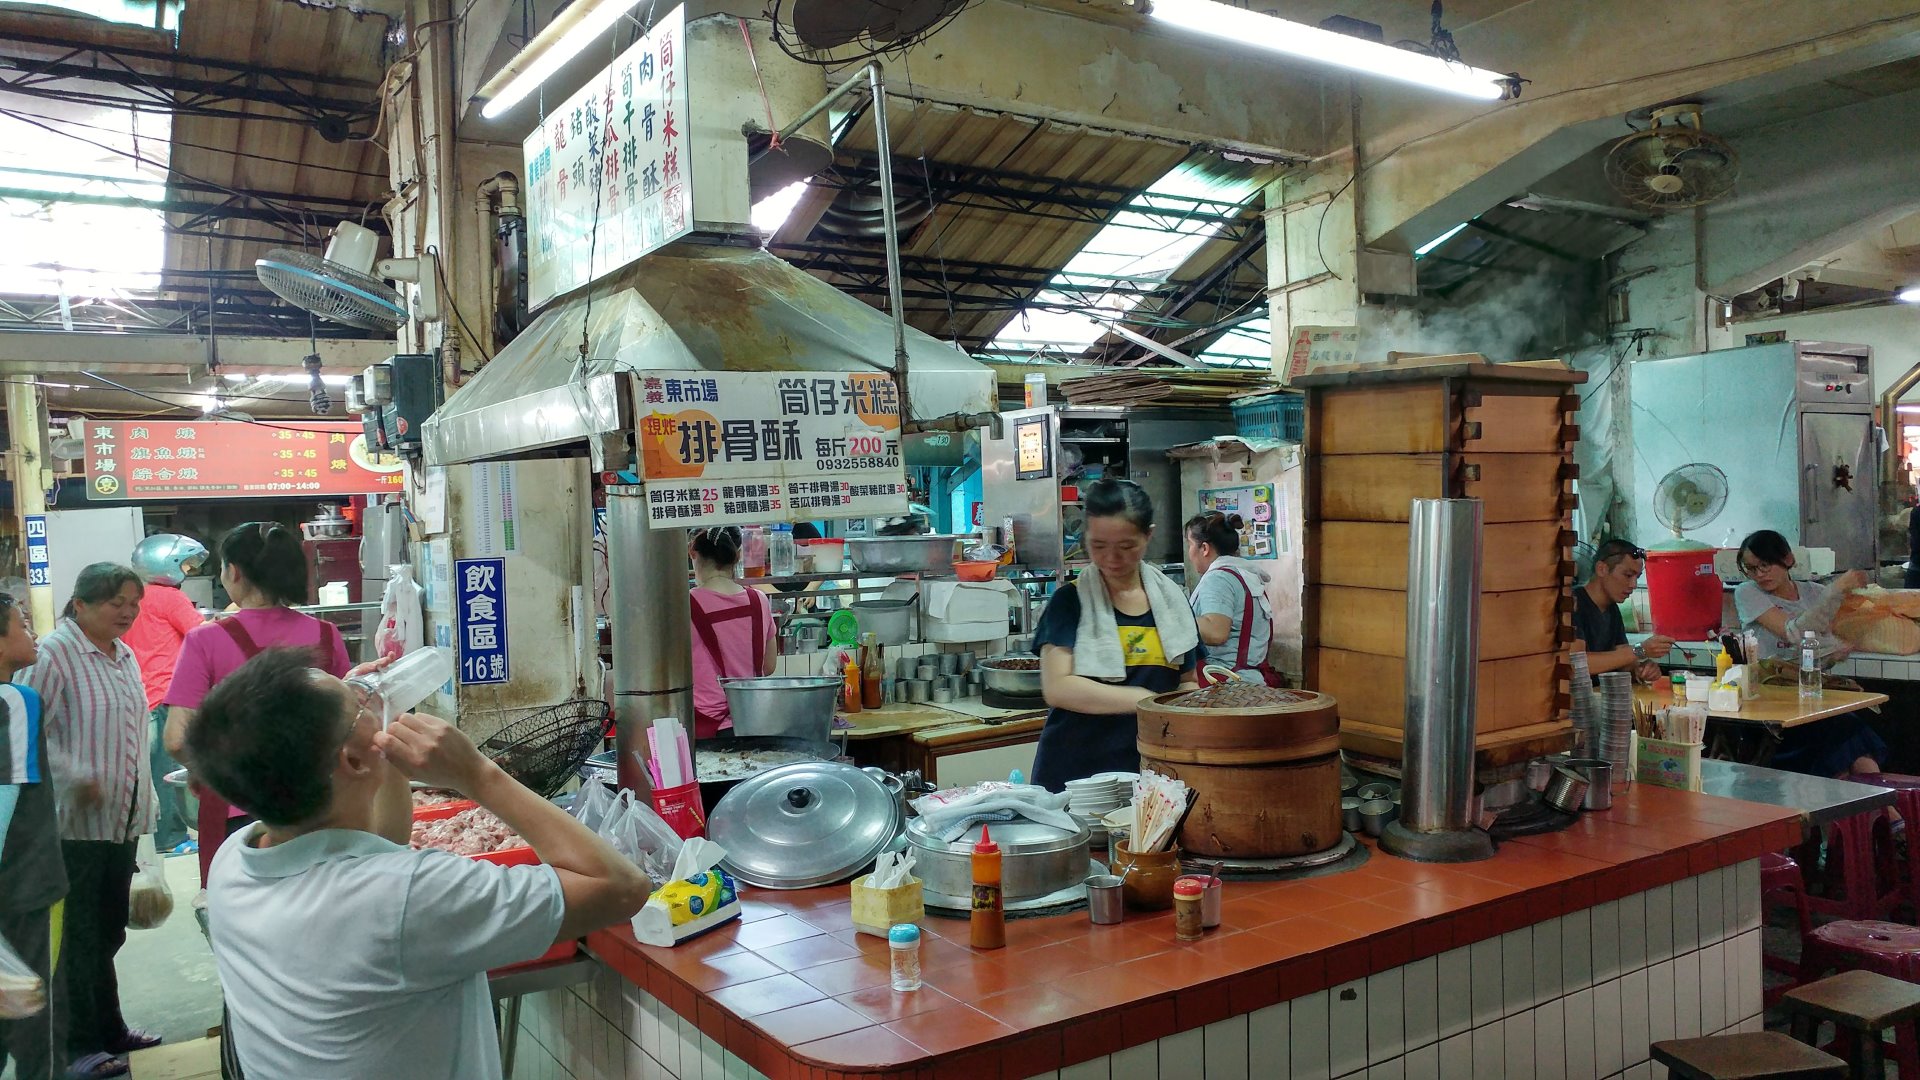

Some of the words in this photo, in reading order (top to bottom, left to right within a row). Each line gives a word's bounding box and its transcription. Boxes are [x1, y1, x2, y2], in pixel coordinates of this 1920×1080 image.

[659, 29, 681, 188] 筒仔米糕
[639, 51, 662, 199] 肉骨酥
[644, 376, 665, 404] 嘉義
[664, 378, 719, 403] 東市場
[778, 378, 899, 416] 筒仔米糕
[278, 430, 292, 440] 35
[302, 430, 316, 440] 45
[646, 417, 677, 436] 現炸
[93, 425, 117, 473] 東市場
[677, 419, 803, 464] 排骨酥
[815, 437, 847, 458] 每斤
[848, 436, 882, 455] 200
[885, 439, 899, 456] 元
[279, 449, 293, 459] 35
[303, 449, 317, 459] 45
[816, 456, 899, 471] 0932558840
[280, 468, 295, 478] 35
[304, 468, 318, 478] 45
[387, 474, 403, 484] 160
[266, 481, 321, 491] 07:00-14:00
[768, 485, 781, 496] 35
[840, 481, 850, 491] 30
[849, 483, 896, 497] 酸菜豬肚湯
[896, 484, 906, 494] 30
[650, 487, 701, 504] 筒仔米糕
[701, 488, 719, 501] 25
[789, 494, 841, 509] 苦瓜排骨湯
[841, 495, 851, 504] 30
[652, 503, 702, 520] 排骨酥湯
[702, 503, 715, 514] 30
[770, 499, 782, 510] 35
[26, 520, 49, 563] 四區
[464, 564, 498, 650] 飲食區
[464, 653, 505, 680] 16號
